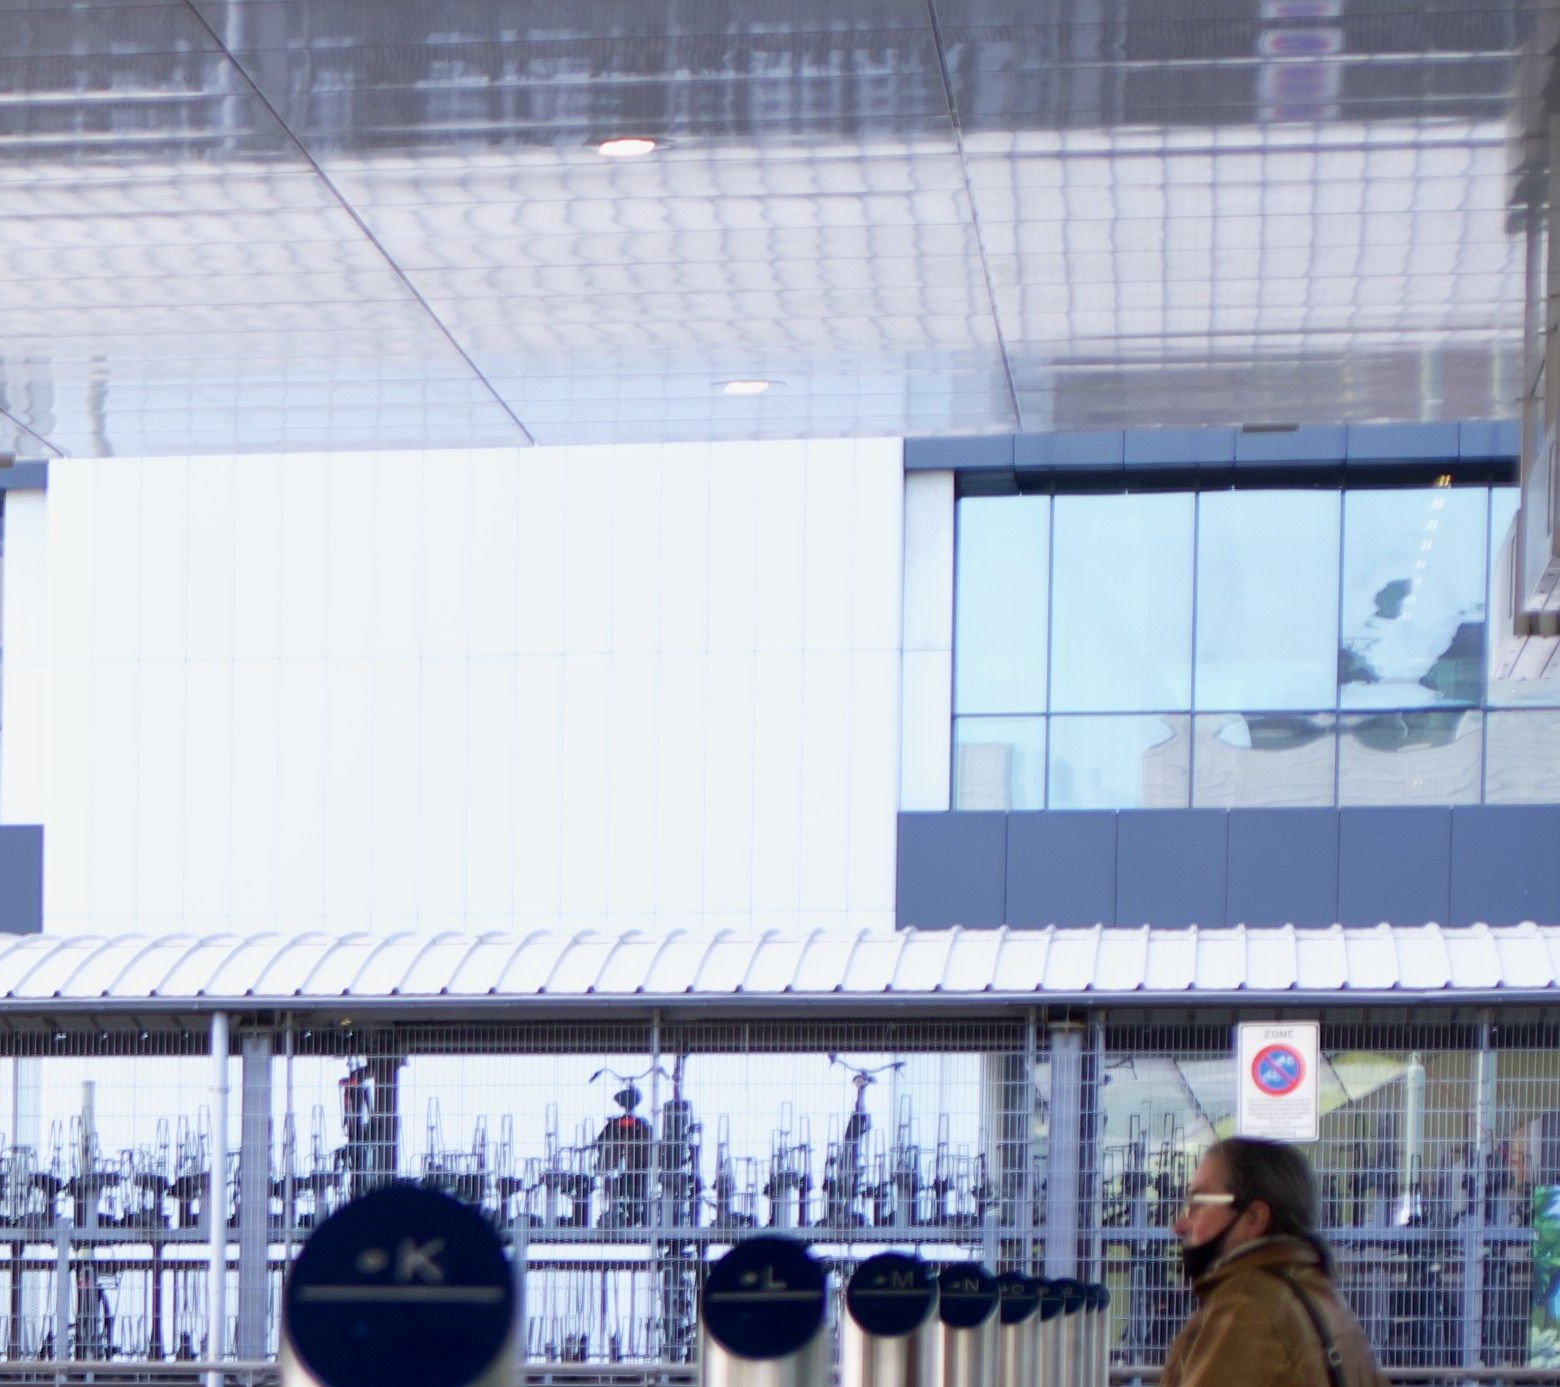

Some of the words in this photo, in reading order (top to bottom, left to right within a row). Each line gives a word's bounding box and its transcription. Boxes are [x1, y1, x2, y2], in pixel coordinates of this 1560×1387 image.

[397, 1237, 445, 1282] K
[766, 1264, 787, 1290] L
[891, 1269, 915, 1287] M
[964, 1277, 980, 1293] N
